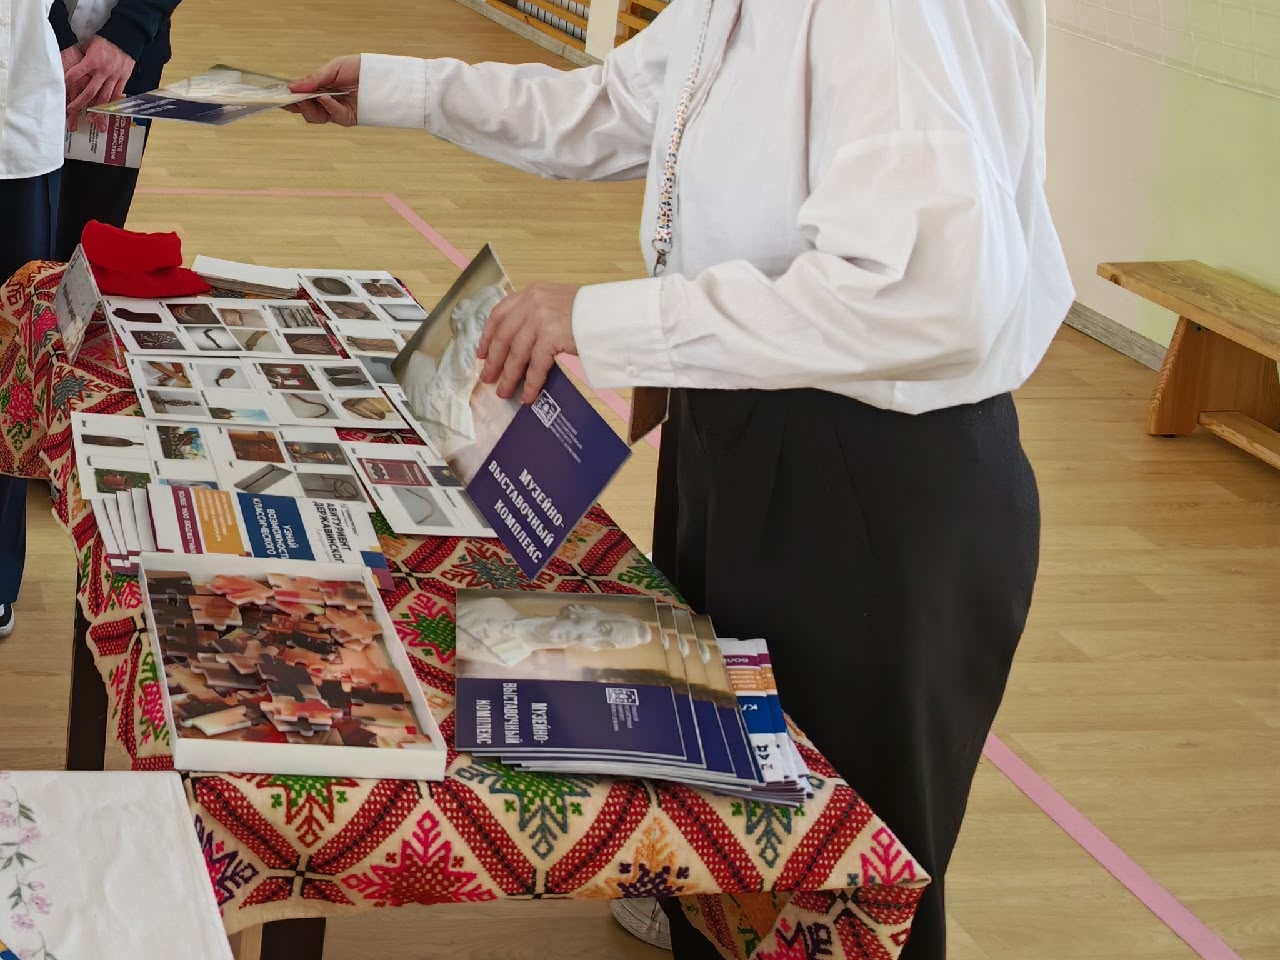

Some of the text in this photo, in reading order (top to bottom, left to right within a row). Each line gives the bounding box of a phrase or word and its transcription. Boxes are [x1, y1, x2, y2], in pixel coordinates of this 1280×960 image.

[251, 497, 276, 555] КЛАССИЧЕСКОГО
[326, 503, 351, 551] АБИТУРИЕНТ
[487, 459, 555, 548] ВЫСТАВОЧНЫЙ
[518, 468, 565, 528] МУЗЕЙНО-
[282, 525, 299, 548] УЗНАЙ
[311, 501, 344, 563] ДЕРЖАВИНСКОГ
[493, 498, 543, 564] КОМПЛЕКС
[476, 699, 493, 744] КОМПЛЕКС
[502, 683, 523, 744] ВЫСТАВОЧНЫЙ
[531, 703, 550, 744] МУЗЕЙНО-
